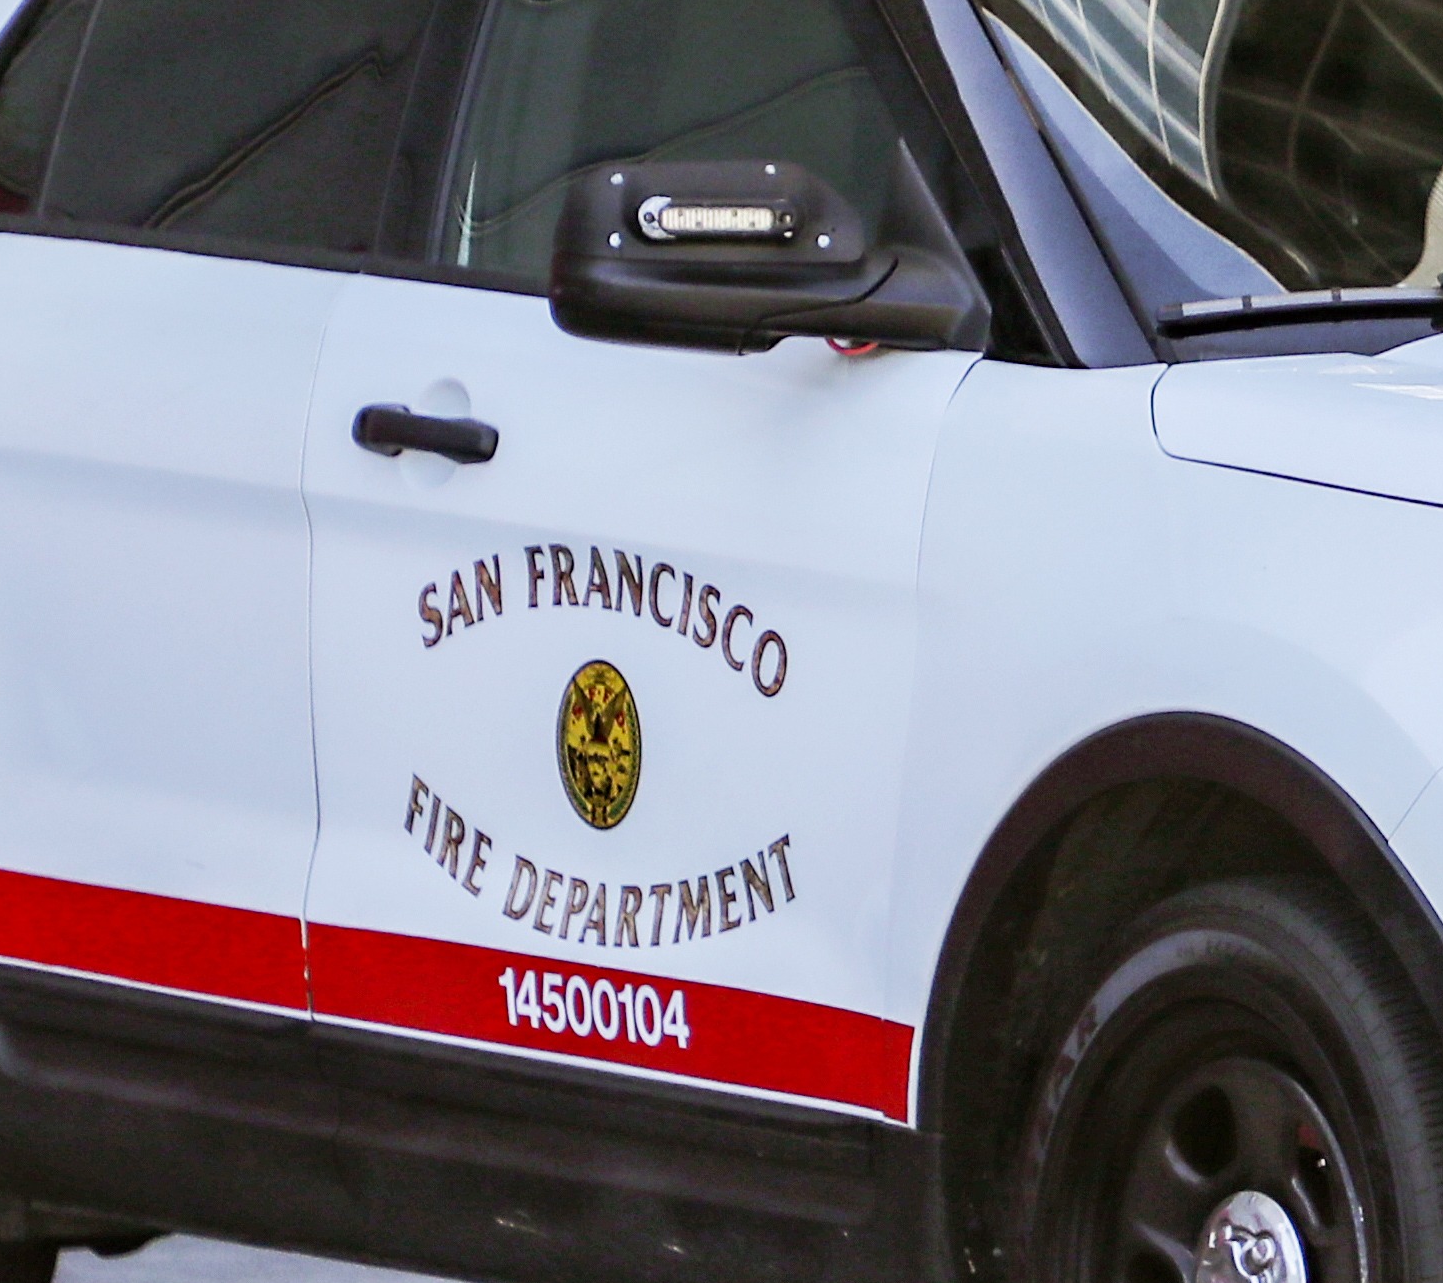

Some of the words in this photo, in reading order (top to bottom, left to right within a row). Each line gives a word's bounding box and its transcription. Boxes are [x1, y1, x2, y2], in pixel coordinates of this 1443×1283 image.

[418, 554, 503, 648] SAN
[523, 544, 787, 697] FRANCISCO
[404, 773, 493, 897] FIRE
[502, 833, 796, 948] DEPARTMENT
[498, 967, 691, 1049] 14500104
